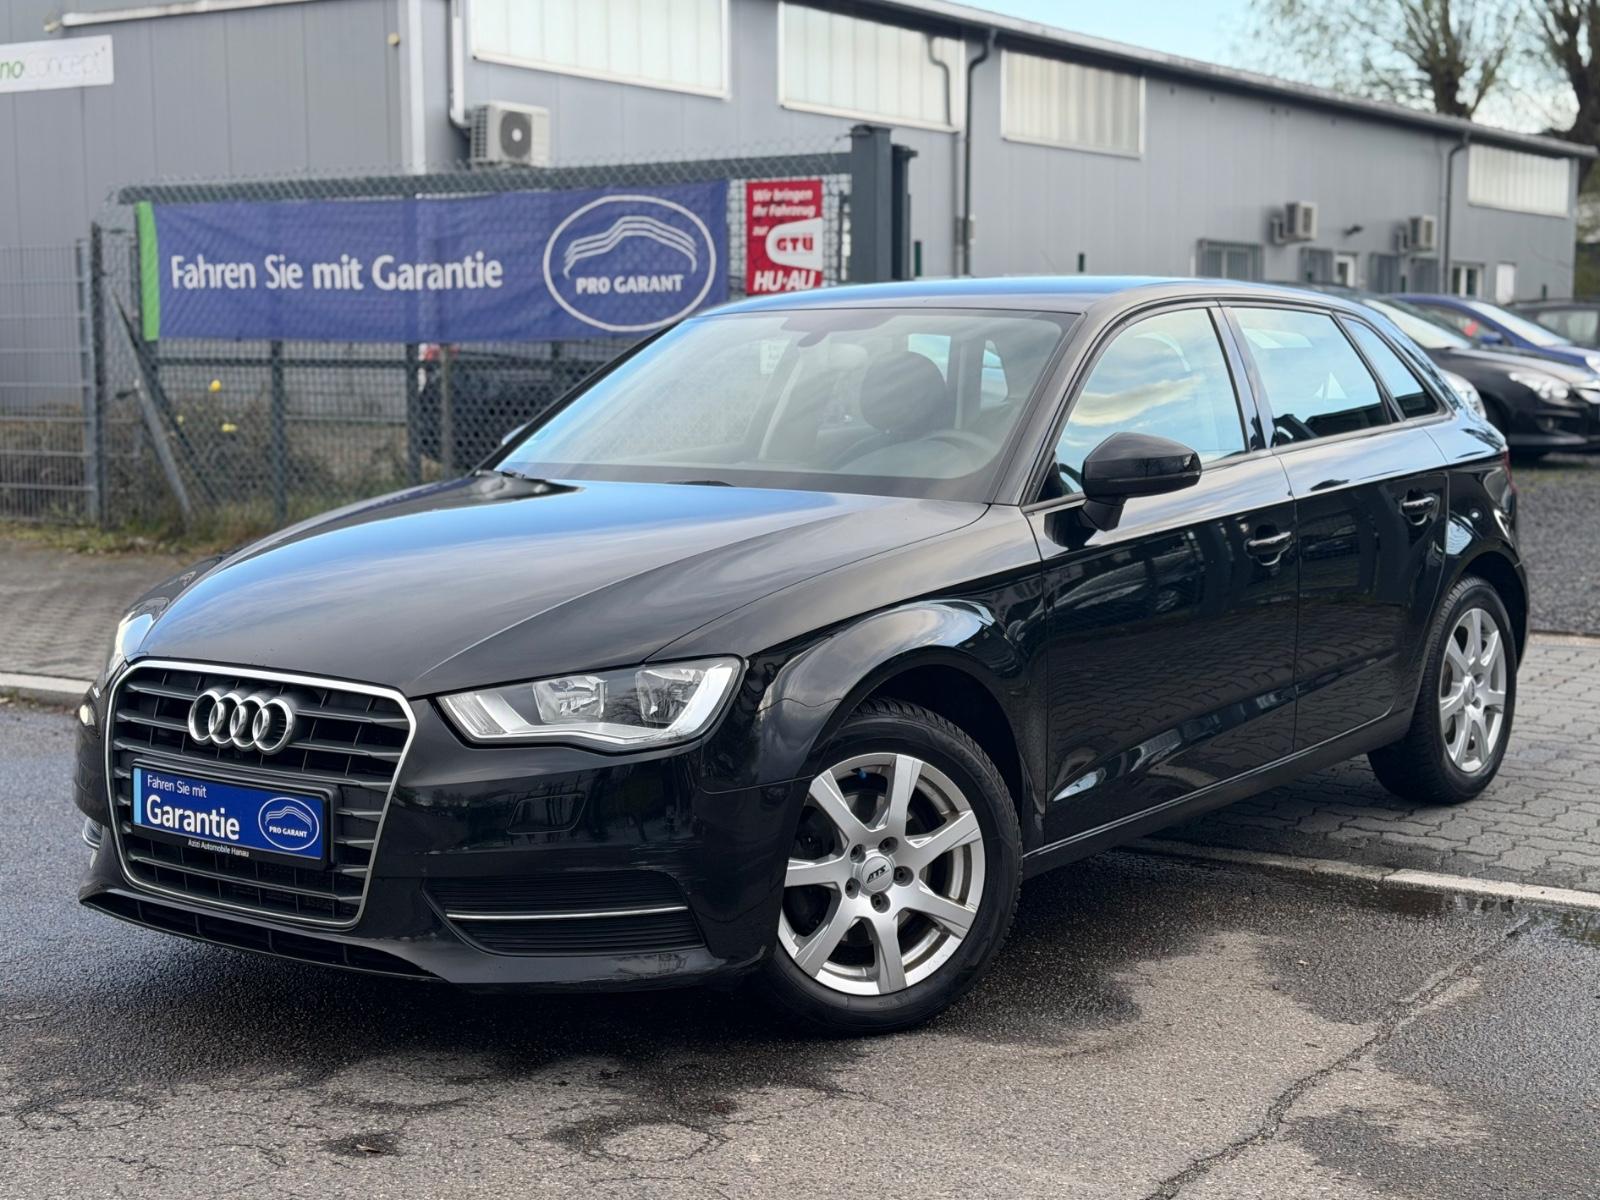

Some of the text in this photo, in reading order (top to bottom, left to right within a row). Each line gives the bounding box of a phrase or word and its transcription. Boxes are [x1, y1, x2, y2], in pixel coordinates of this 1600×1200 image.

[772, 188, 814, 204] bringen
[171, 250, 504, 291] Fahren Sie mit Garantie
[575, 273, 684, 295] PRO GARANT
[147, 775, 207, 798] Fahren Sie mit
[146, 794, 240, 840] Garantie
[269, 825, 308, 838] PRO GARANT
[200, 841, 231, 855] Automobile
[231, 847, 250, 858] Hanau
